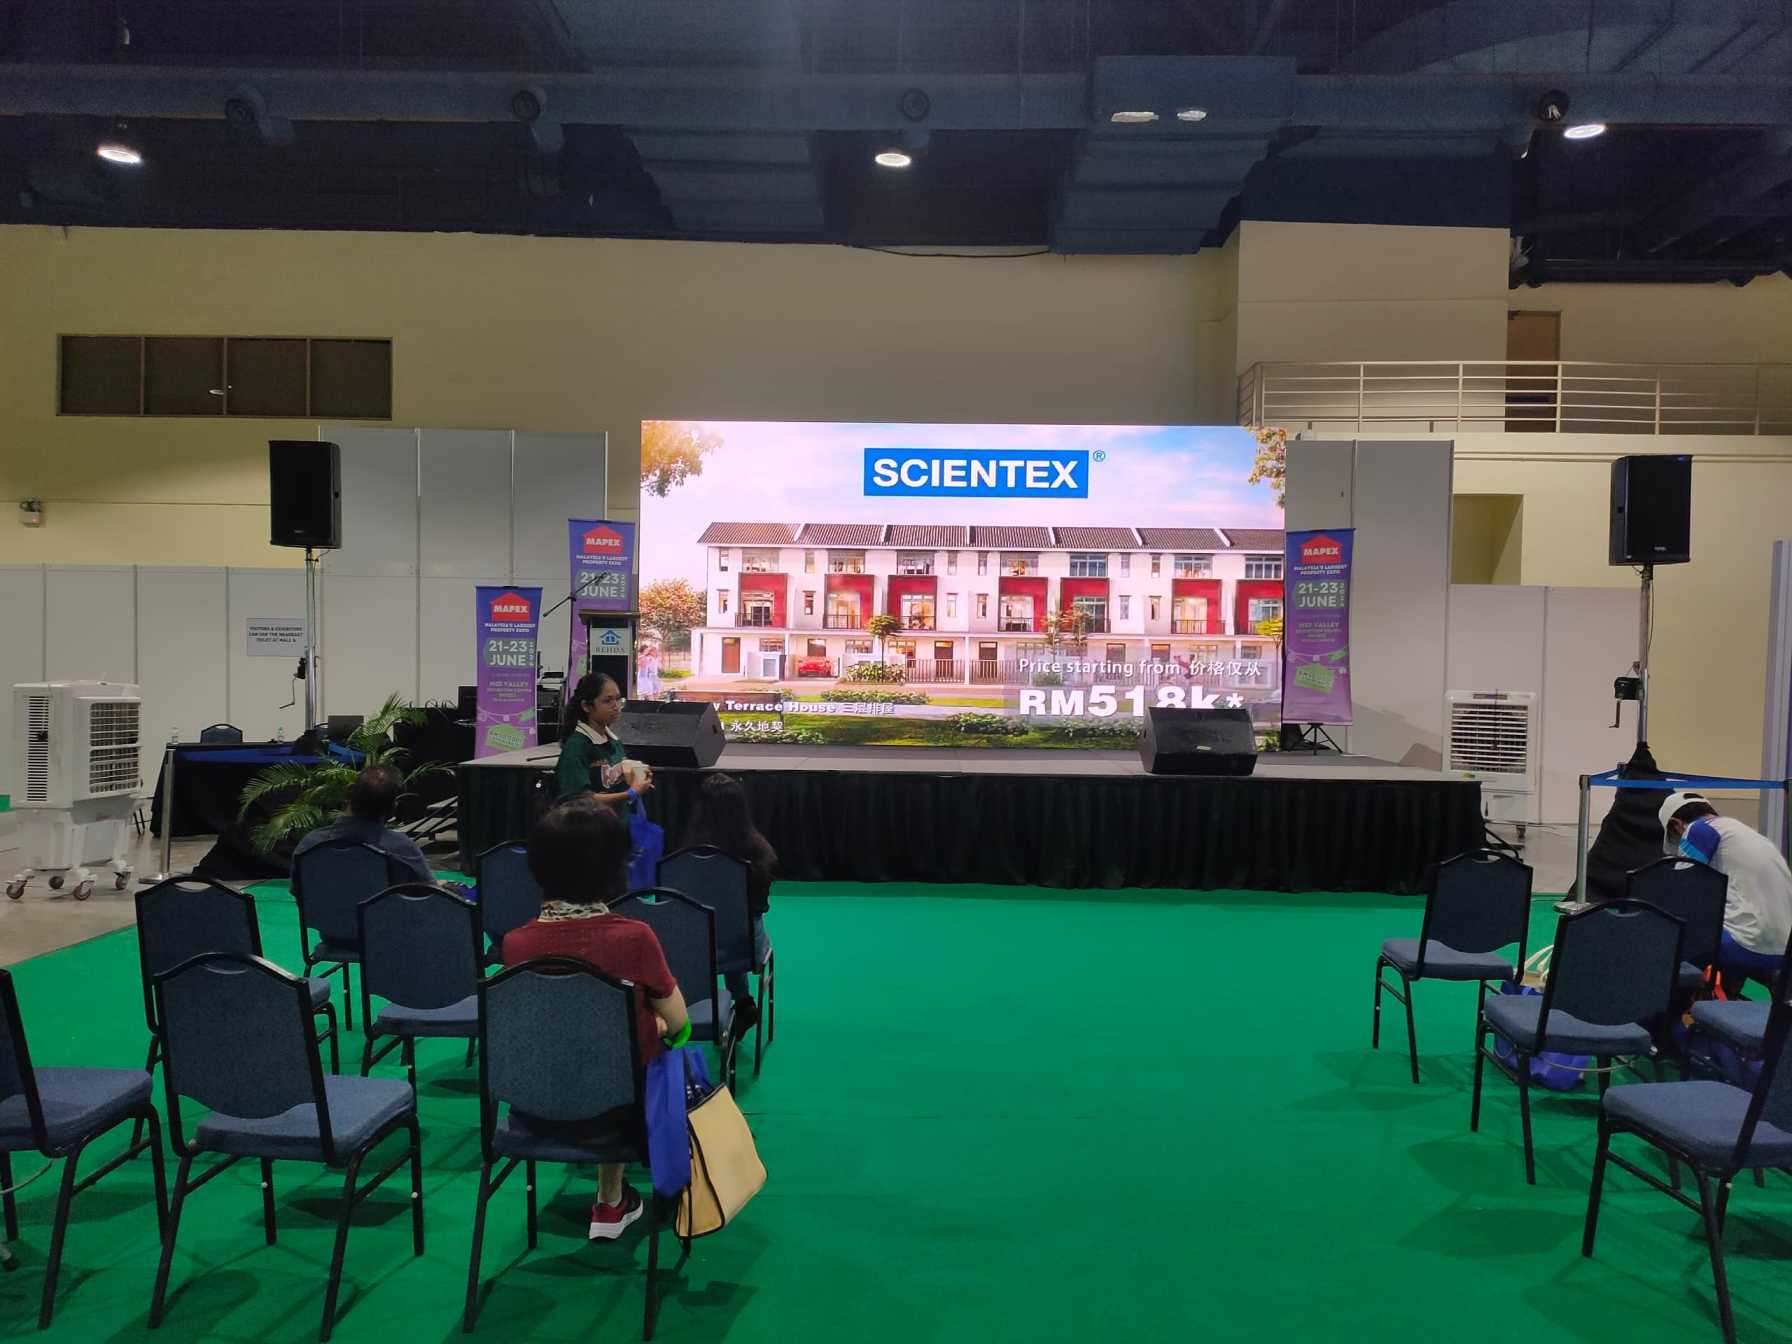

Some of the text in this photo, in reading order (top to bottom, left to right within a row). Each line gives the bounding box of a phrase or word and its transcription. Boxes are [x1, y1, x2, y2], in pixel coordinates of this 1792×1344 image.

[872, 458, 1079, 489] SCIENTEX
[586, 538, 621, 546] MAPEX
[1303, 547, 1339, 556] MAPEX
[580, 572, 620, 584] 2123
[581, 586, 618, 598] JUNE
[1298, 582, 1339, 594] 21-23
[1298, 595, 1337, 608] JUNE
[493, 605, 529, 613] MAPEX
[488, 640, 528, 652] 21-23
[489, 654, 527, 666] JUNE
[1019, 658, 1262, 677] Price starting from 价格仅从
[726, 700, 784, 712] Terrace
[788, 702, 837, 713] House
[730, 720, 785, 733] 永久地契
